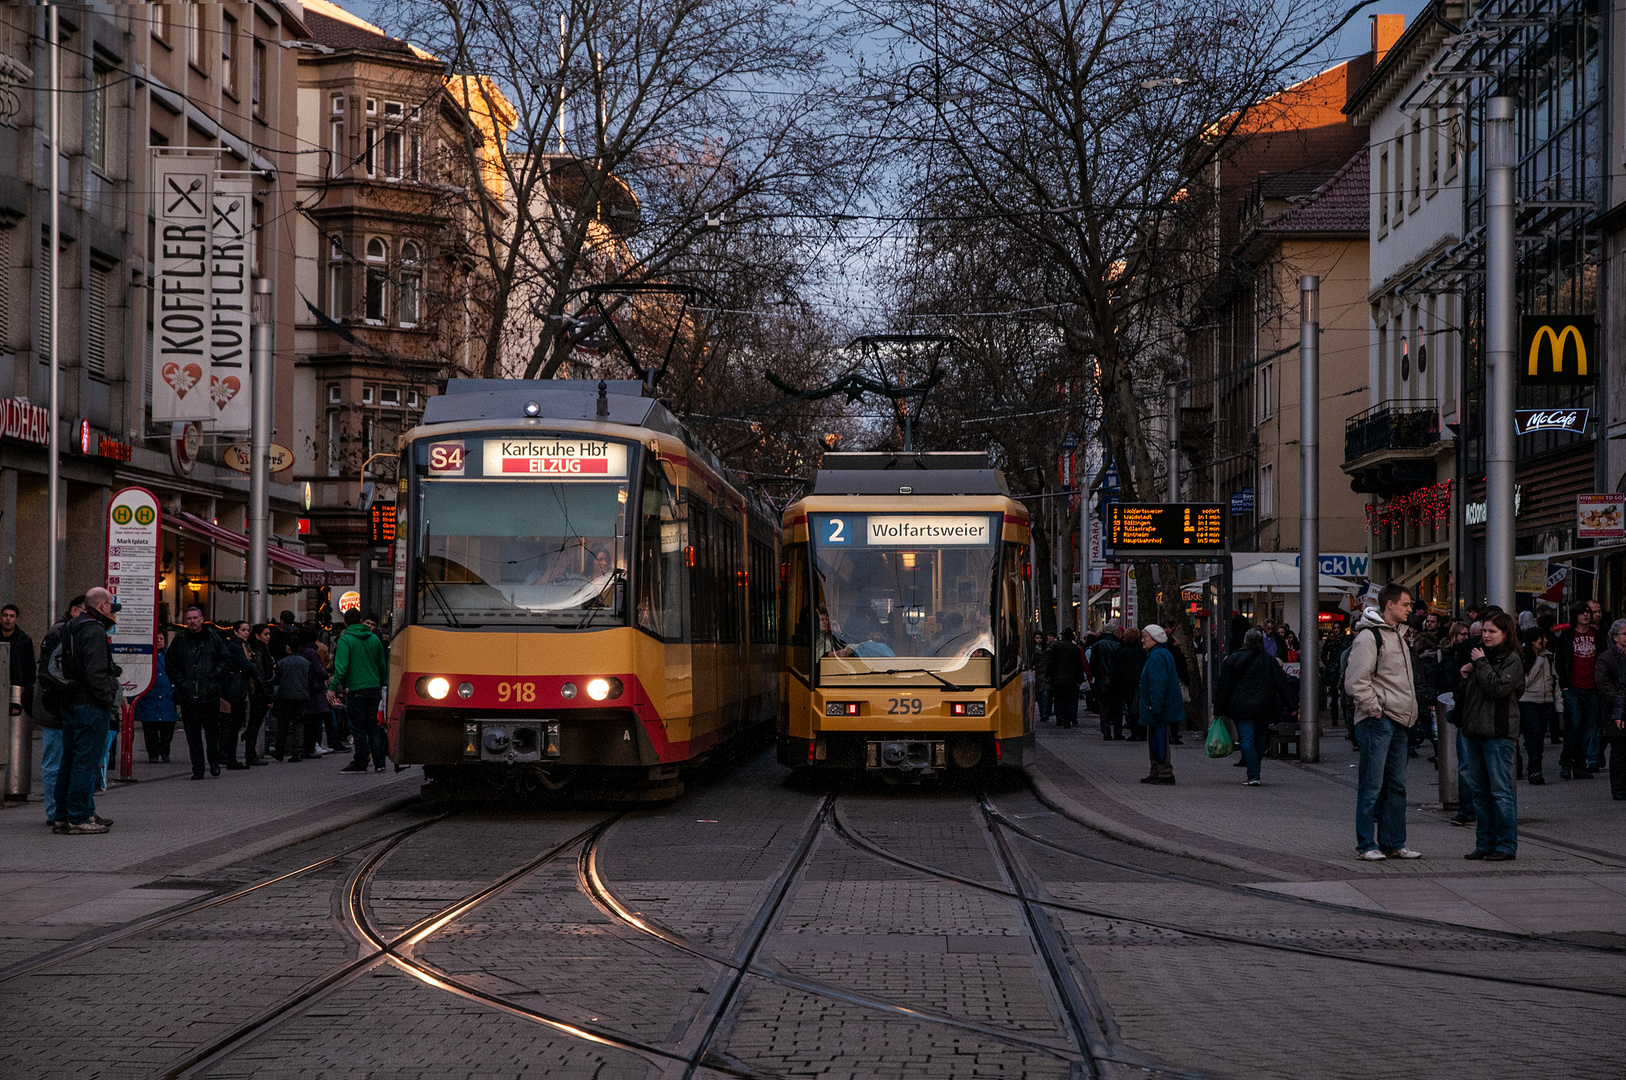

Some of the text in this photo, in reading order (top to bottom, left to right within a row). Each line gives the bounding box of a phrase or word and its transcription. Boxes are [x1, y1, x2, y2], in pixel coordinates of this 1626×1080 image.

[161, 225, 206, 355] KOFFLER
[211, 245, 244, 367] KOFFLER
[431, 447, 463, 468] S4
[502, 441, 608, 457] Karlsruhe Hbf
[529, 459, 581, 473] EILZUG
[829, 518, 985, 542] 2 Wolfartsweier
[117, 538, 149, 546] Marktplatz
[110, 548, 120, 556] S2
[497, 682, 536, 702] 918
[888, 698, 922, 716] 259
[623, 730, 631, 741] A
